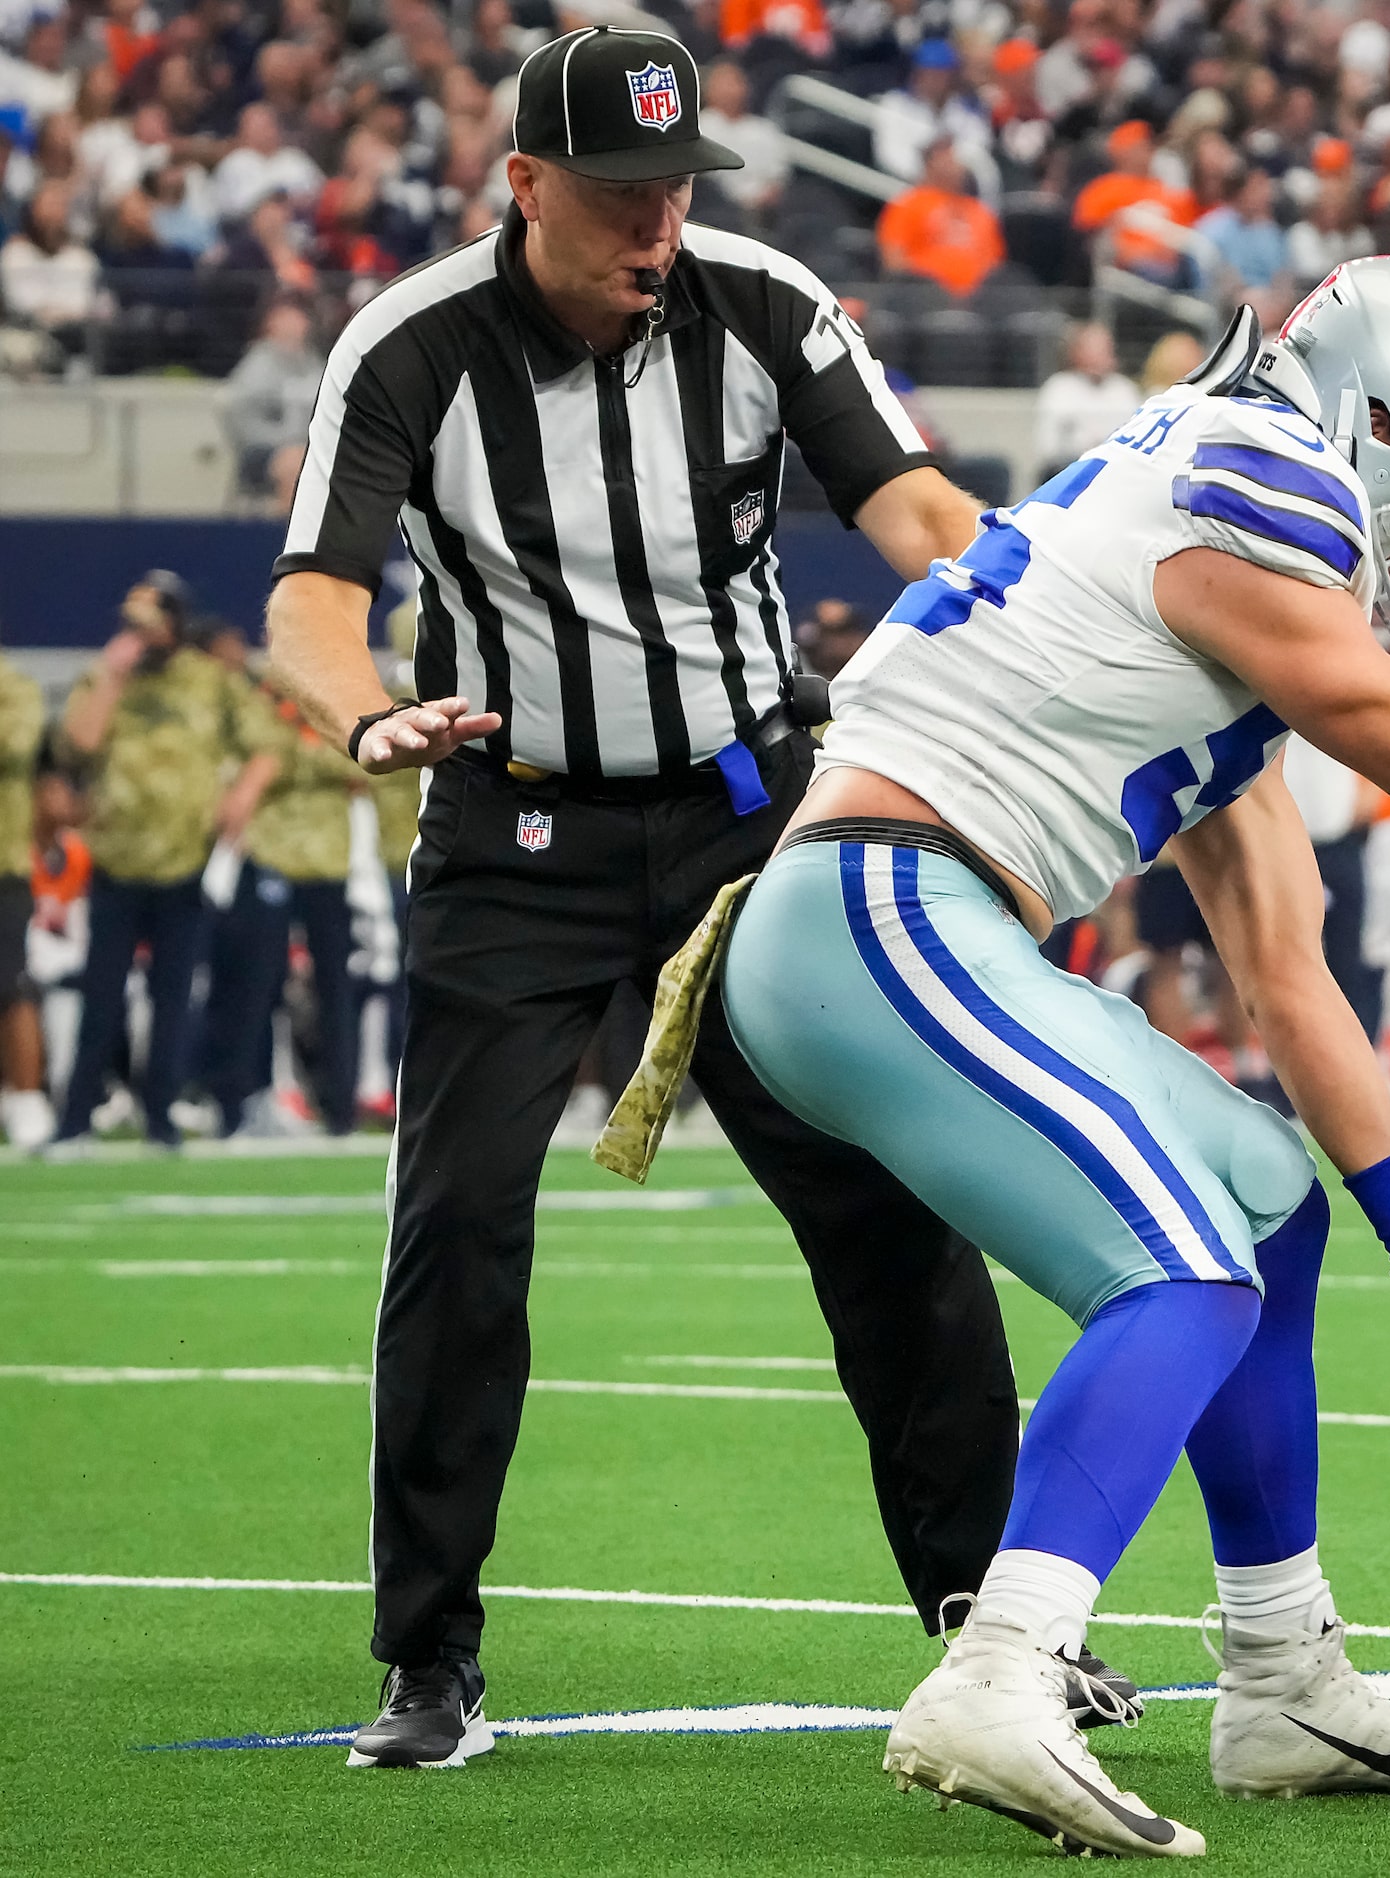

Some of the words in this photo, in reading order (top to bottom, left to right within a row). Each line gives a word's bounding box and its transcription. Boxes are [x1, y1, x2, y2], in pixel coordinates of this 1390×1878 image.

[637, 90, 677, 121] NFL
[736, 509, 761, 538] NFL
[522, 827, 546, 846] NFL
